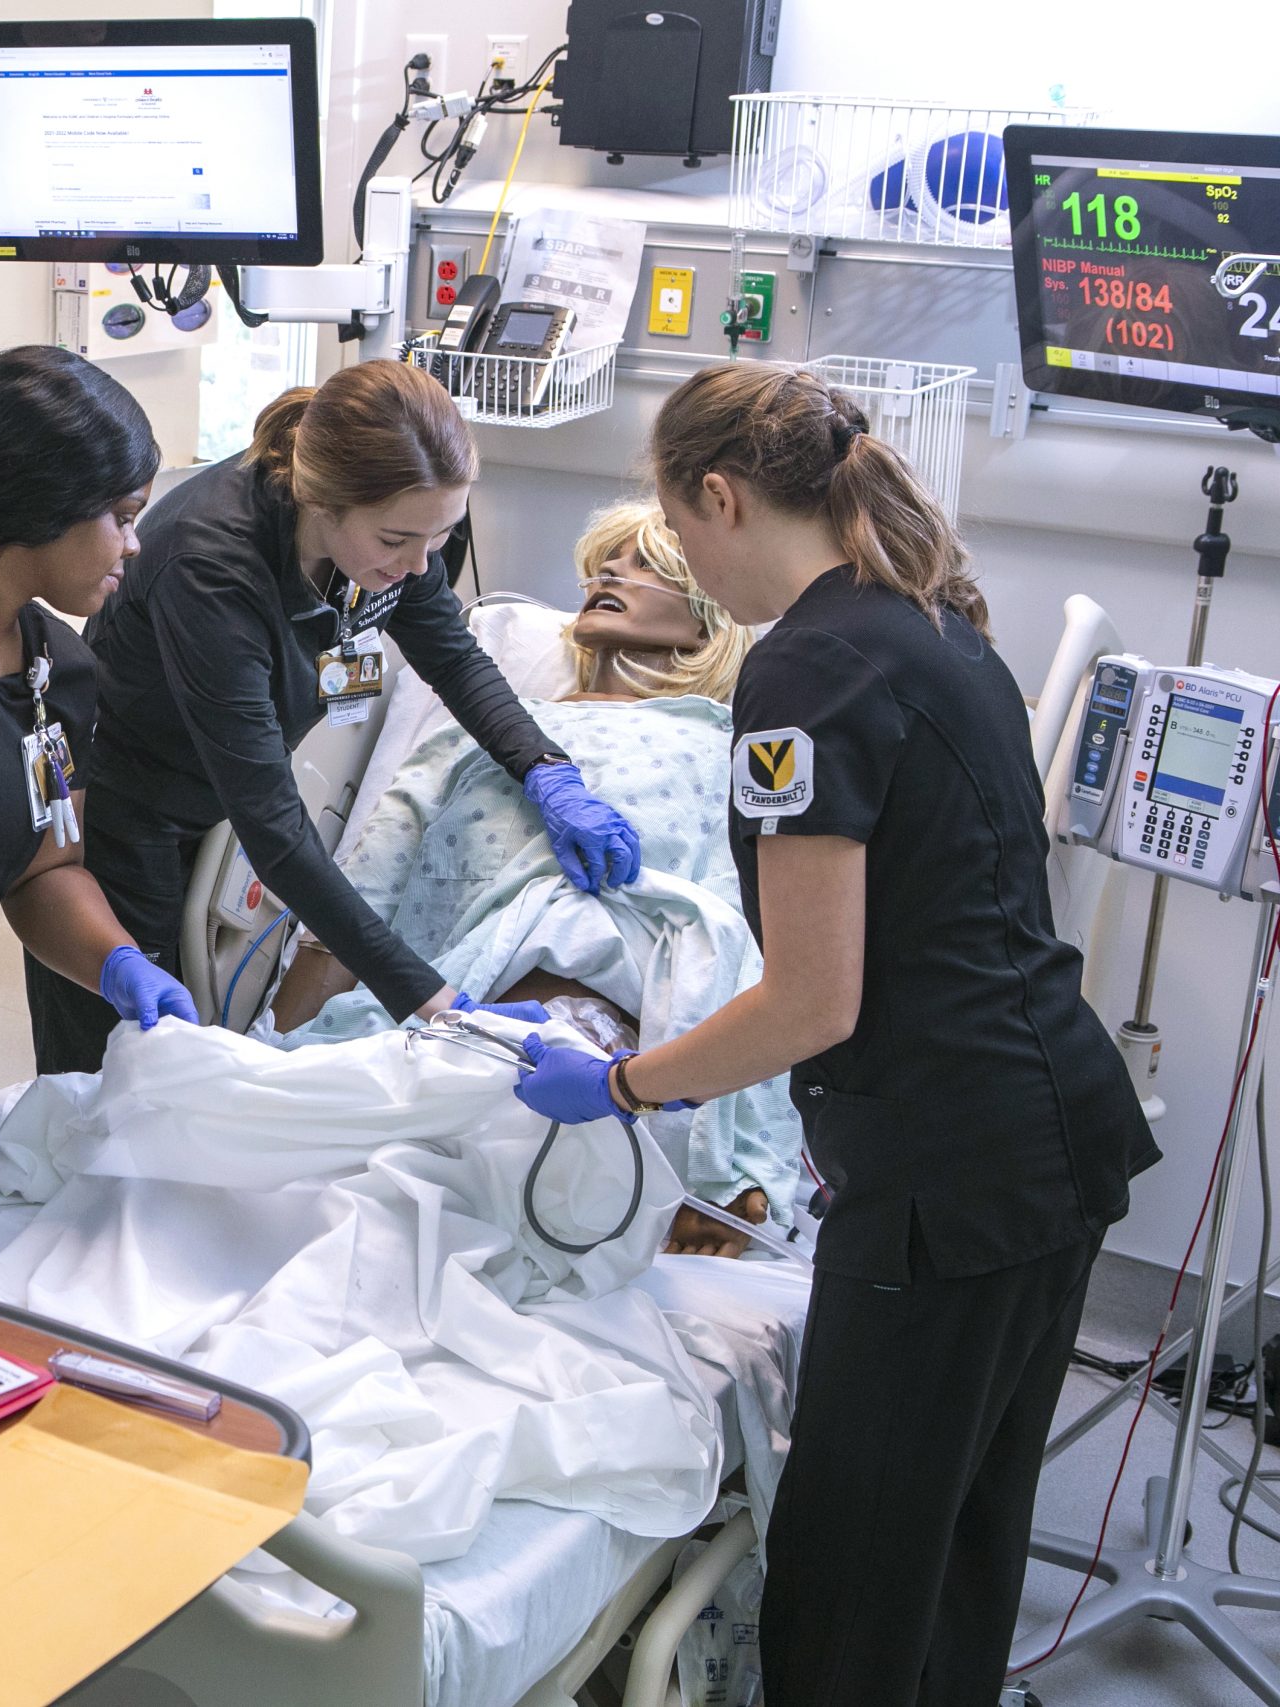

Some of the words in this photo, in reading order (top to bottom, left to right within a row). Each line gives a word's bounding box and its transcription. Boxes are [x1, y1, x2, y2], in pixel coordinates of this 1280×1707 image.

[1034, 174, 1051, 186] HR
[1212, 201, 1229, 211] 100
[1062, 191, 1141, 240] 118
[1217, 213, 1230, 223] 92
[546, 239, 585, 256] SBAR
[1042, 257, 1076, 274] NIBP
[1080, 261, 1125, 277] Manual
[531, 275, 540, 286] S
[552, 279, 562, 290] B
[573, 285, 583, 296] A
[596, 289, 606, 300] R
[1044, 277, 1069, 291] Sys.
[1079, 277, 1173, 313] 138/84
[1106, 318, 1174, 351] (102)
[358, 611, 378, 628] School
[1185, 683, 1197, 692] BD
[1225, 692, 1242, 702] PCU
[336, 703, 360, 712] STUDENT
[1170, 720, 1178, 730] B
[751, 791, 798, 804] VANDERBILT
